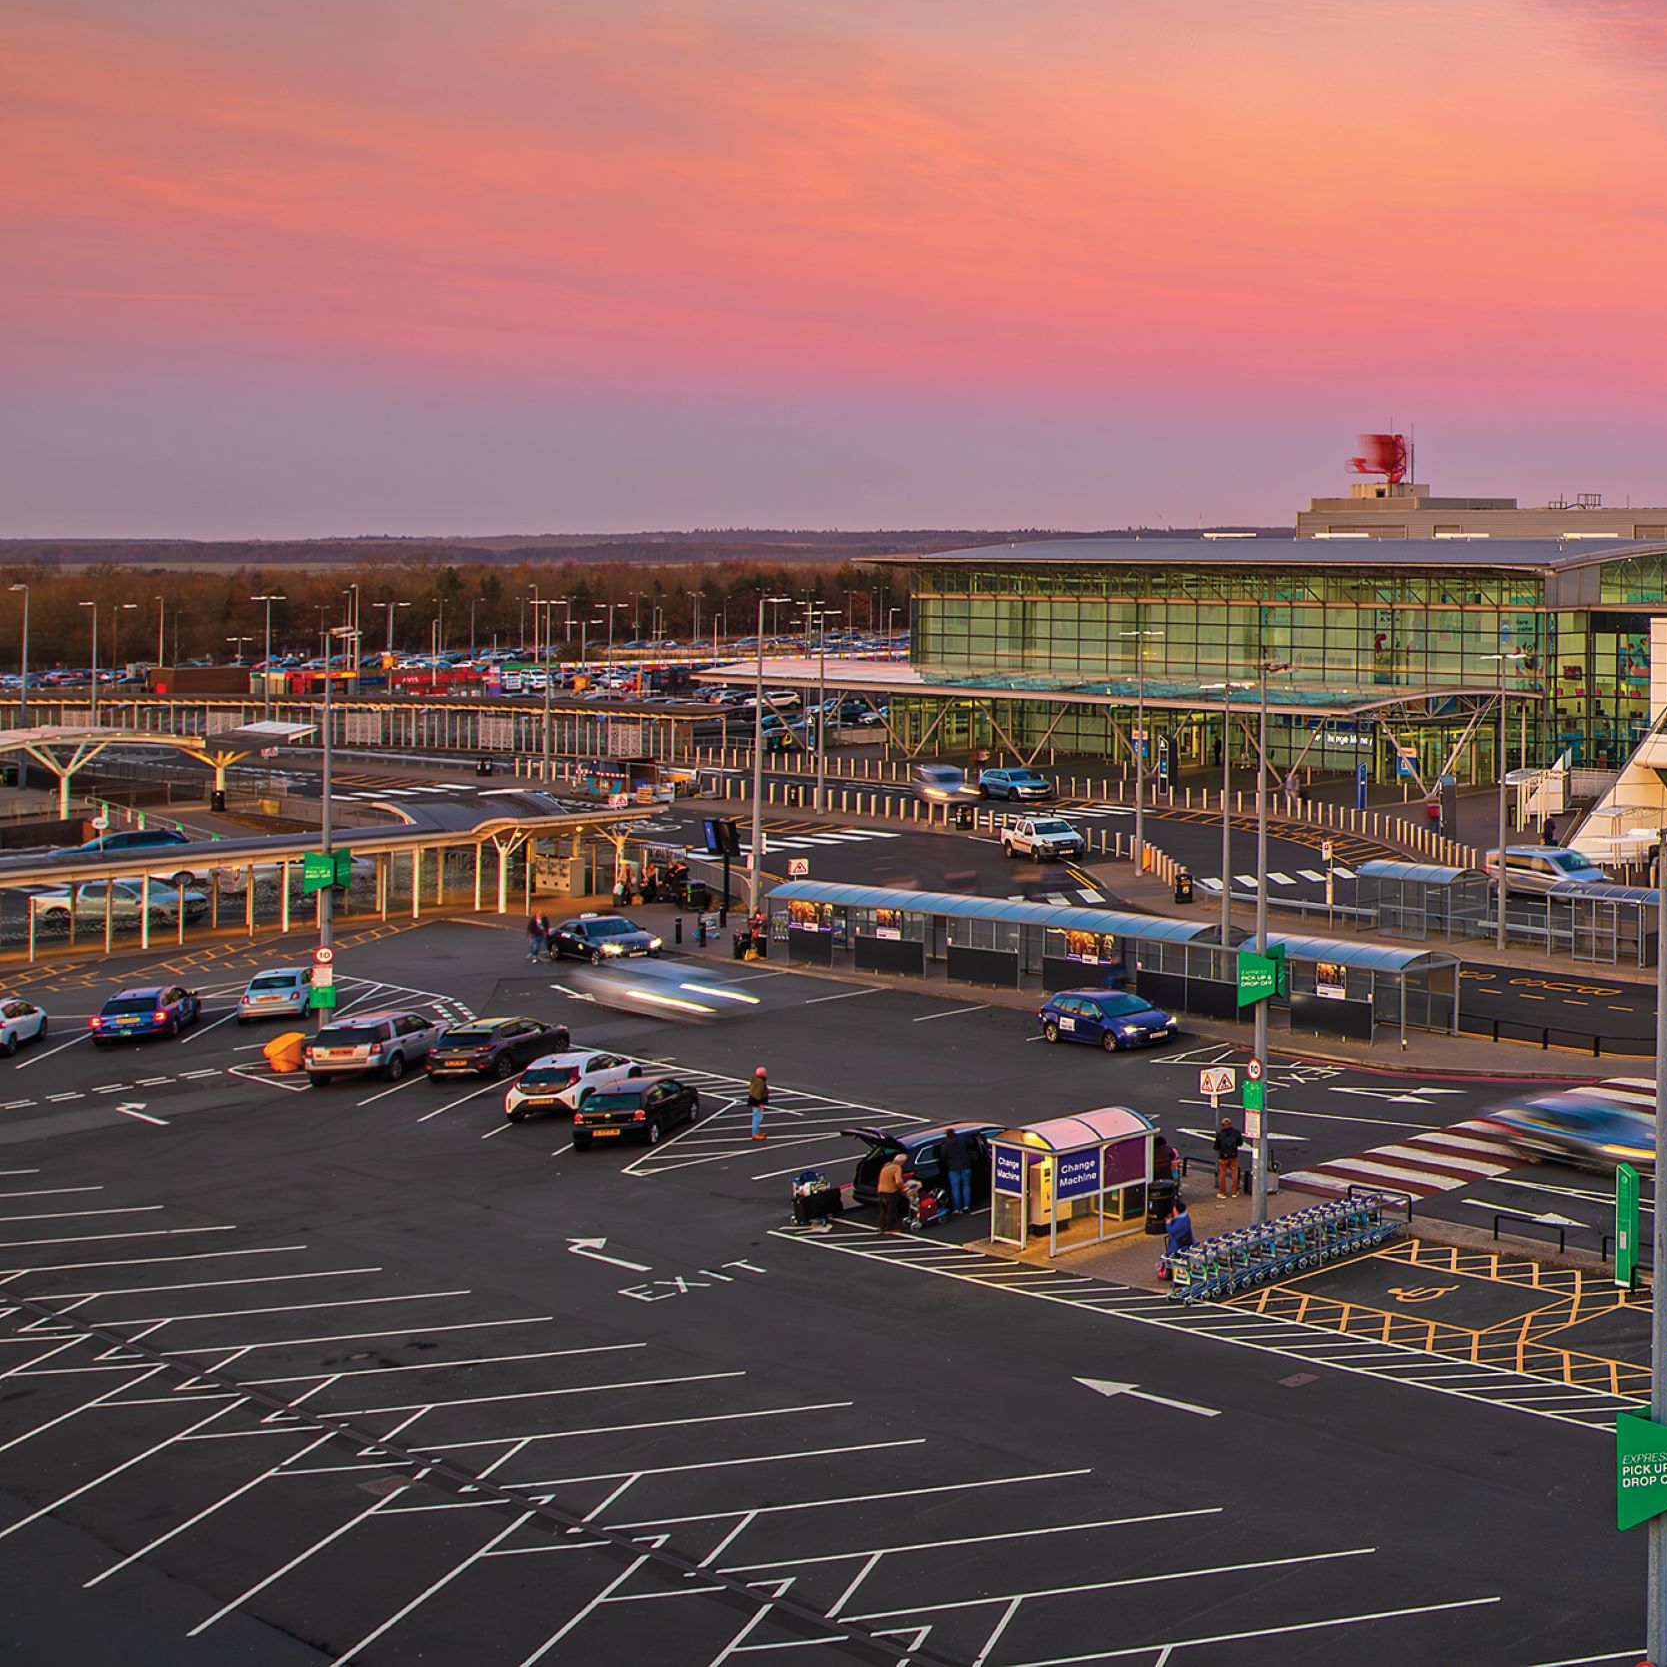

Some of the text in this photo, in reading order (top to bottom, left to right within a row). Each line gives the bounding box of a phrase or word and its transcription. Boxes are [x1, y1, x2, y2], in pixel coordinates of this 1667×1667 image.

[318, 951, 330, 960] 10
[997, 1156, 1020, 1170] Change
[1060, 1159, 1096, 1175] Change
[996, 1168, 1021, 1182] Machine
[1059, 1171, 1097, 1188] Machine
[616, 1258, 768, 1303] EXIT
[1622, 1464, 1651, 1476] PICK
[1622, 1475, 1657, 1488] DROP
